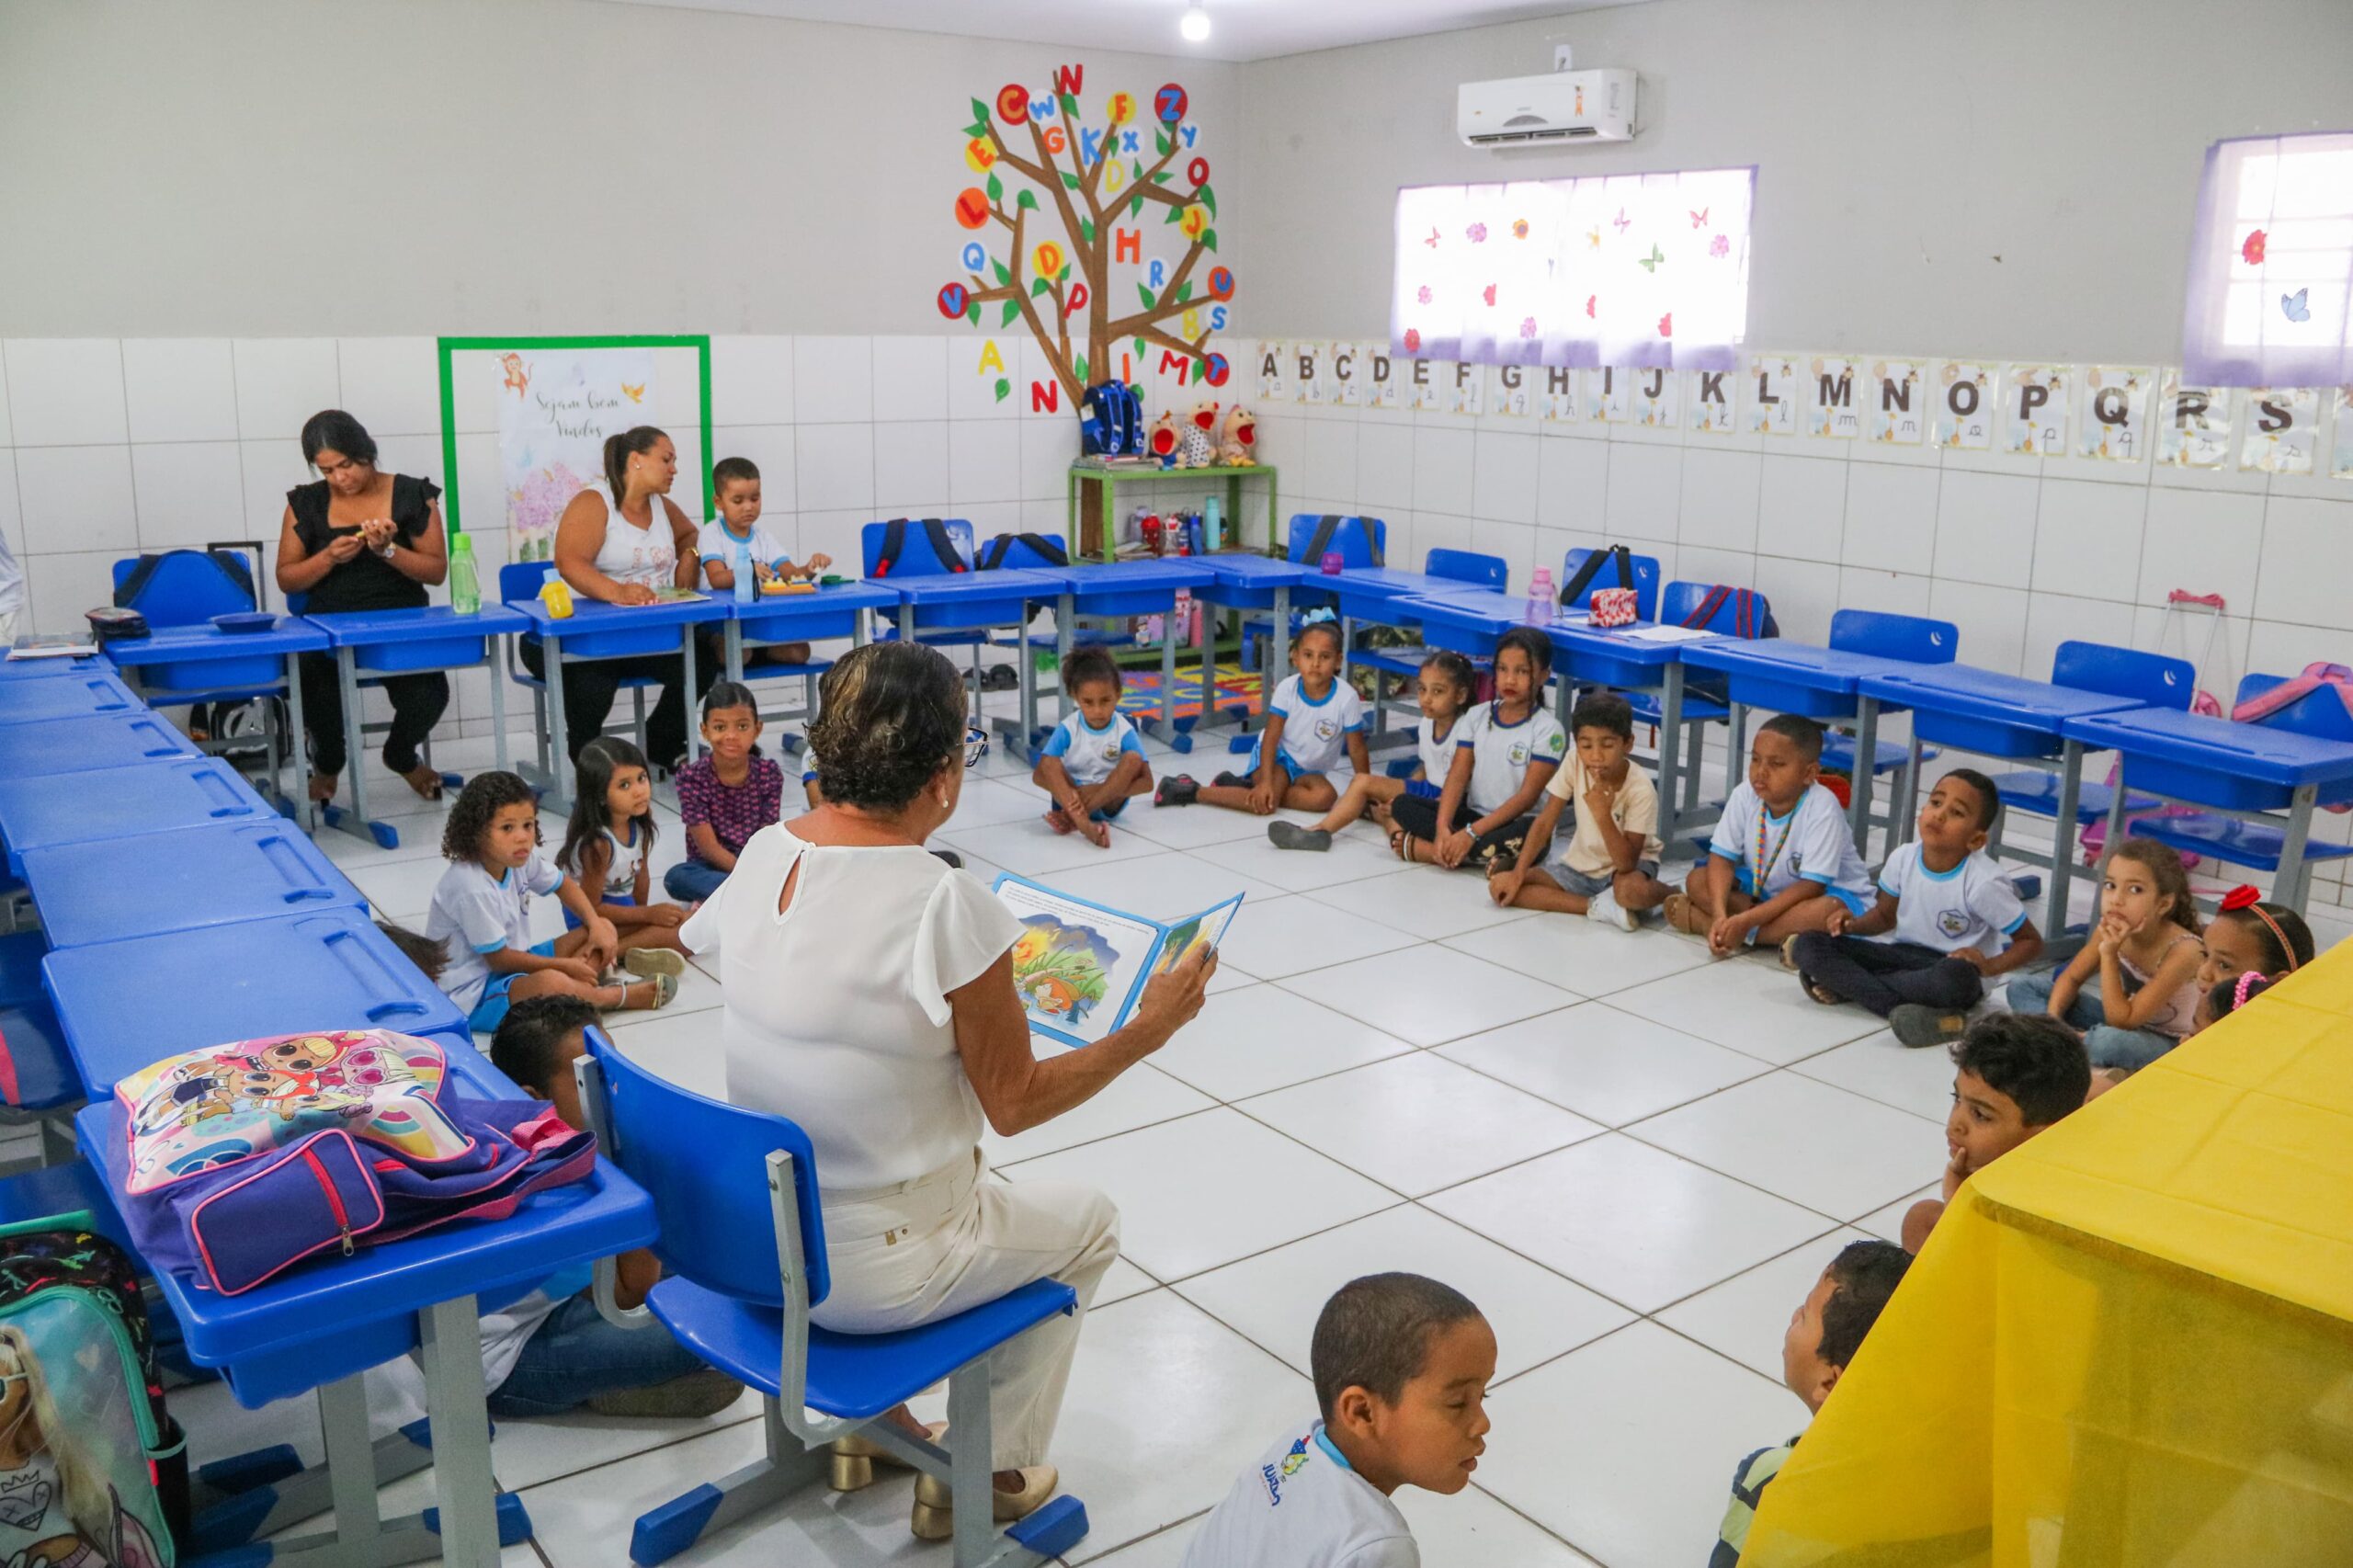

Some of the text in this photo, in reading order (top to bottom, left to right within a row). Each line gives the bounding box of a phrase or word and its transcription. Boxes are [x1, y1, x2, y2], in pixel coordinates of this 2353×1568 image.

[1059, 63, 1083, 96] N
[1000, 89, 1026, 119] C
[1029, 95, 1055, 120] W
[1115, 94, 1127, 121] F
[1160, 90, 1181, 120] Z
[1042, 126, 1065, 154] G
[1081, 127, 1103, 165] K
[1122, 131, 1140, 153] X
[1180, 126, 1197, 148] Y
[968, 139, 995, 167] E
[1106, 159, 1124, 193] D
[1188, 157, 1210, 187] O
[958, 196, 986, 225] L
[1186, 210, 1200, 234] J
[963, 242, 985, 272] Q
[1038, 244, 1060, 276] D
[1116, 228, 1141, 265] H
[1150, 260, 1164, 289] R
[1214, 271, 1233, 293] U
[942, 287, 962, 314] V
[1063, 283, 1088, 319] P
[1182, 308, 1199, 341] B
[1211, 306, 1228, 330] S
[978, 339, 1005, 375] A
[1122, 353, 1131, 385] I
[1158, 350, 1189, 387] M
[1210, 354, 1228, 380] T
[1262, 353, 1278, 377] A
[1299, 356, 1314, 380] B
[1336, 355, 1352, 381] C
[1373, 356, 1390, 382] D
[1414, 358, 1429, 384] E
[1456, 362, 1471, 388] F
[1501, 365, 1521, 389] G
[1548, 366, 1569, 395] H
[1604, 366, 1613, 395] I
[1643, 369, 1663, 398] J
[1700, 371, 1725, 403] K
[1758, 372, 1779, 404] L
[1820, 374, 1850, 406] M
[536, 391, 580, 424] Sejam
[1031, 380, 1058, 414] N
[1882, 379, 1910, 412] N
[1948, 381, 1979, 416] O
[2019, 385, 2048, 420] P
[2094, 387, 2129, 428] Q
[2176, 391, 2210, 429] R
[2258, 393, 2292, 433] S
